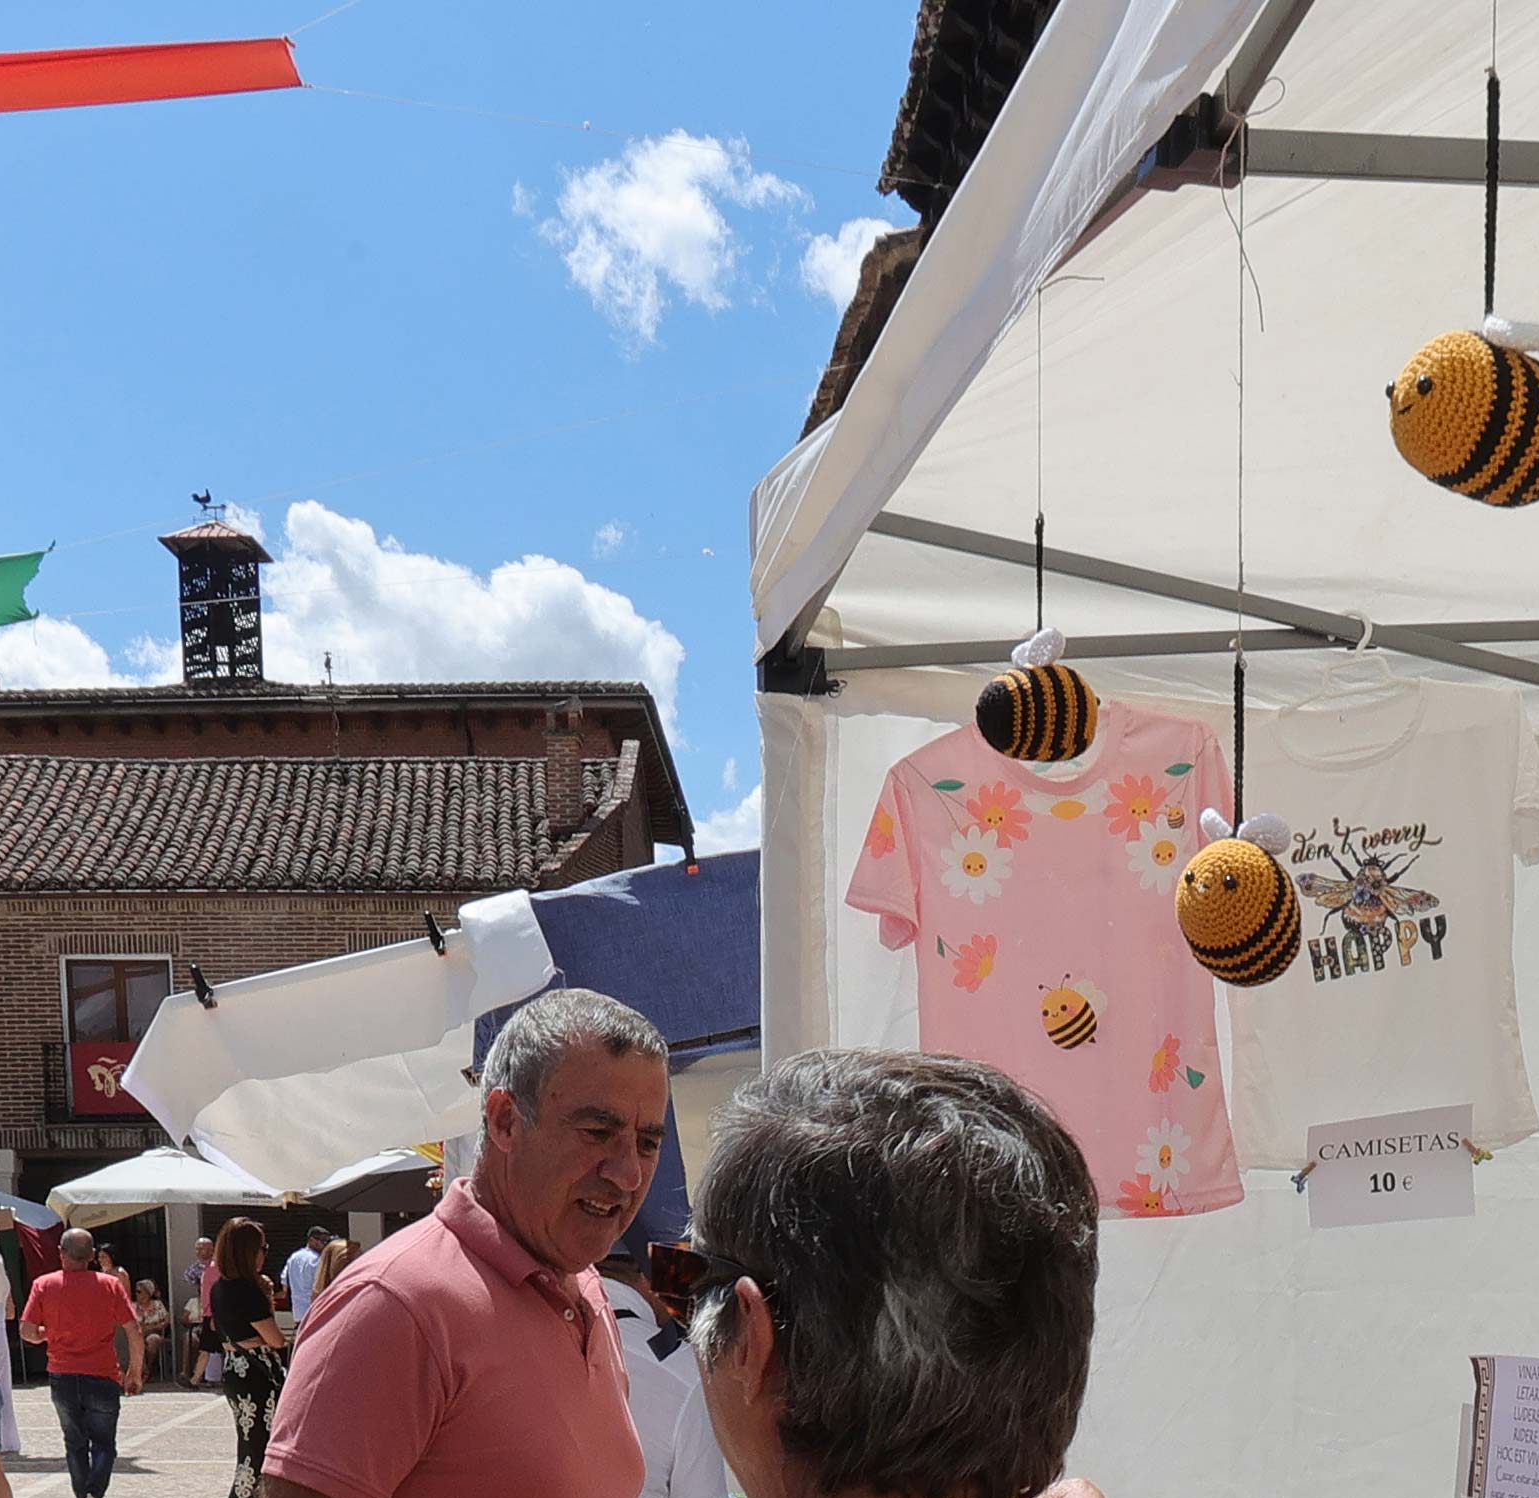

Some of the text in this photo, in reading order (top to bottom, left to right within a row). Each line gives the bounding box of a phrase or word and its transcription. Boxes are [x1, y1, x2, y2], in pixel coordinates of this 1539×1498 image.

[1361, 819, 1444, 857] worry
[1307, 914, 1447, 982] HAPPY
[1318, 1131, 1460, 1162] CAMISETAS
[1369, 1172, 1413, 1193] 10 €
